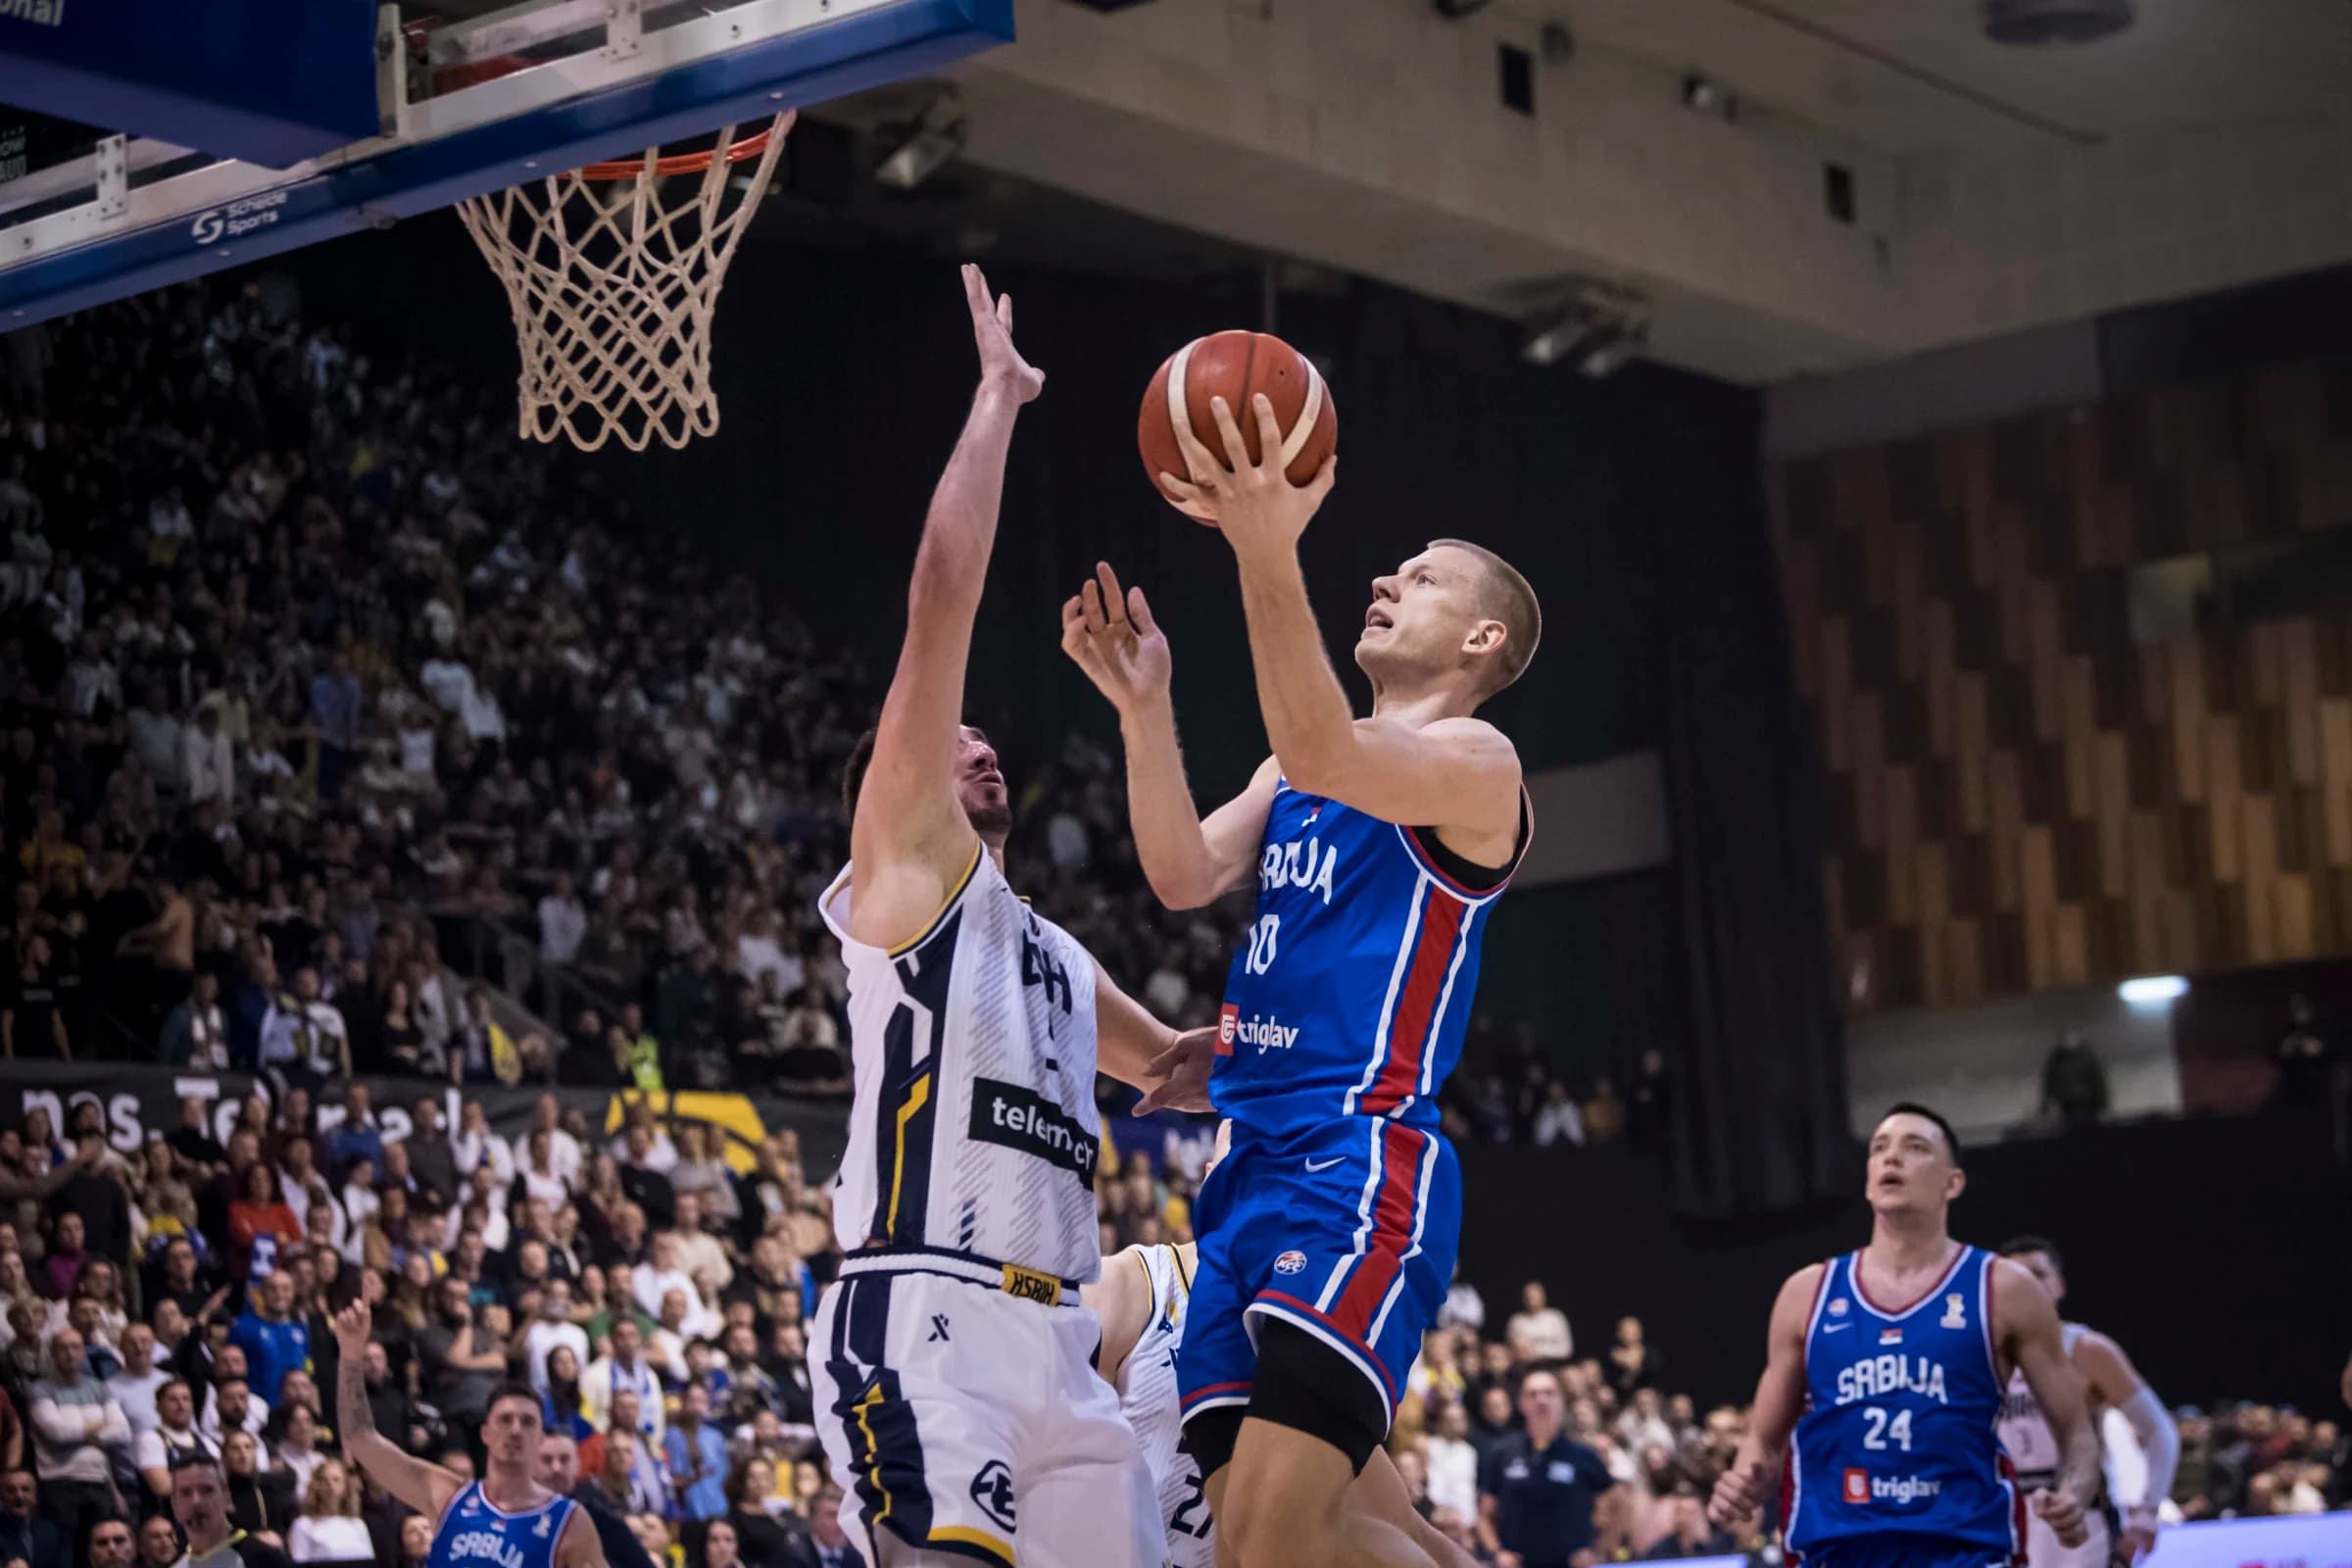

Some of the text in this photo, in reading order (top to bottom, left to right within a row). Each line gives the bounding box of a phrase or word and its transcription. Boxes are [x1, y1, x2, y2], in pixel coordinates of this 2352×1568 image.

[226, 211, 278, 235] Sports
[1245, 914, 1281, 975] 10
[1236, 1013, 1299, 1055] triglav
[1835, 1352, 1949, 1406] SRBIJA
[1863, 1406, 1913, 1452] 24
[1871, 1474, 1941, 1505] triglav
